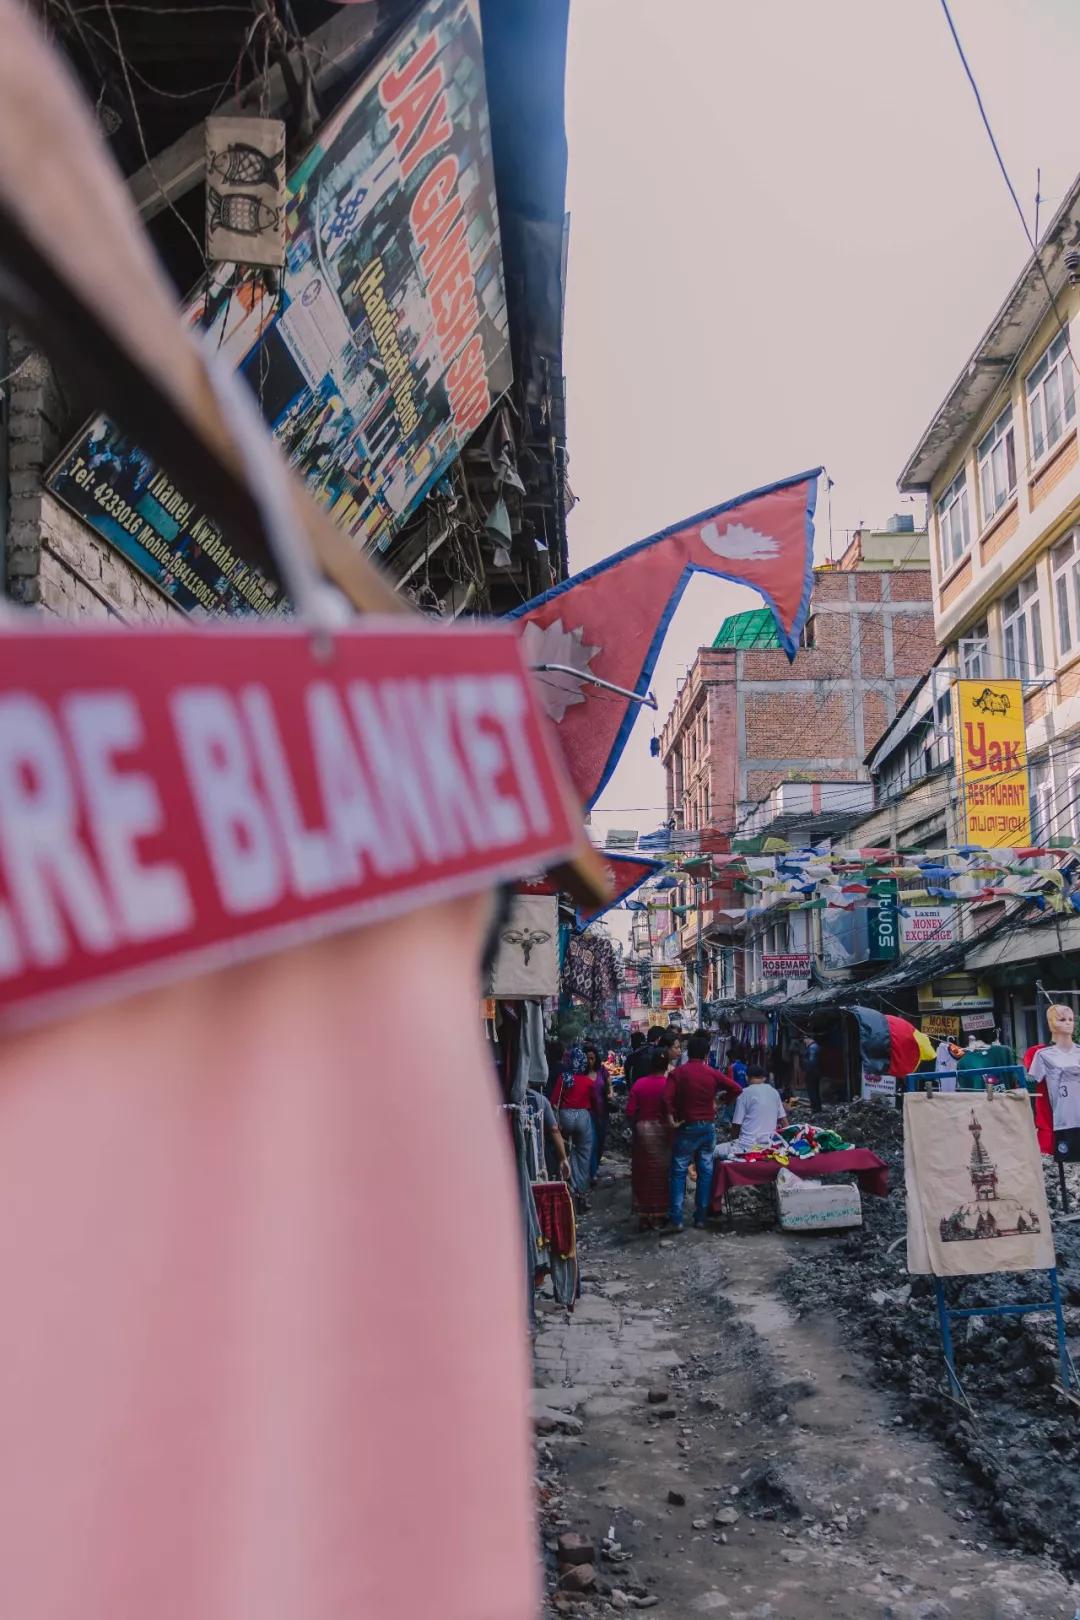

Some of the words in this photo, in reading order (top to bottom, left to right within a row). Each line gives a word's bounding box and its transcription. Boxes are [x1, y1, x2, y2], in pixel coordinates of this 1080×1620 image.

[379, 30, 453, 183] JAY
[410, 154, 480, 366] GANESH
[352, 256, 411, 391] (Handicraft
[446, 333, 491, 438] SHOP
[69, 457, 96, 491] Tel:
[94, 482, 143, 534] 4233016
[964, 722, 1021, 773] Yak
[168, 673, 552, 916] BLANKET
[968, 784, 1025, 806] RESTAURANT
[905, 930, 952, 941] EXCHANGE
[912, 919, 944, 929] MONEY
[762, 960, 810, 970] ROSEMARY
[930, 1015, 957, 1028] MONEY
